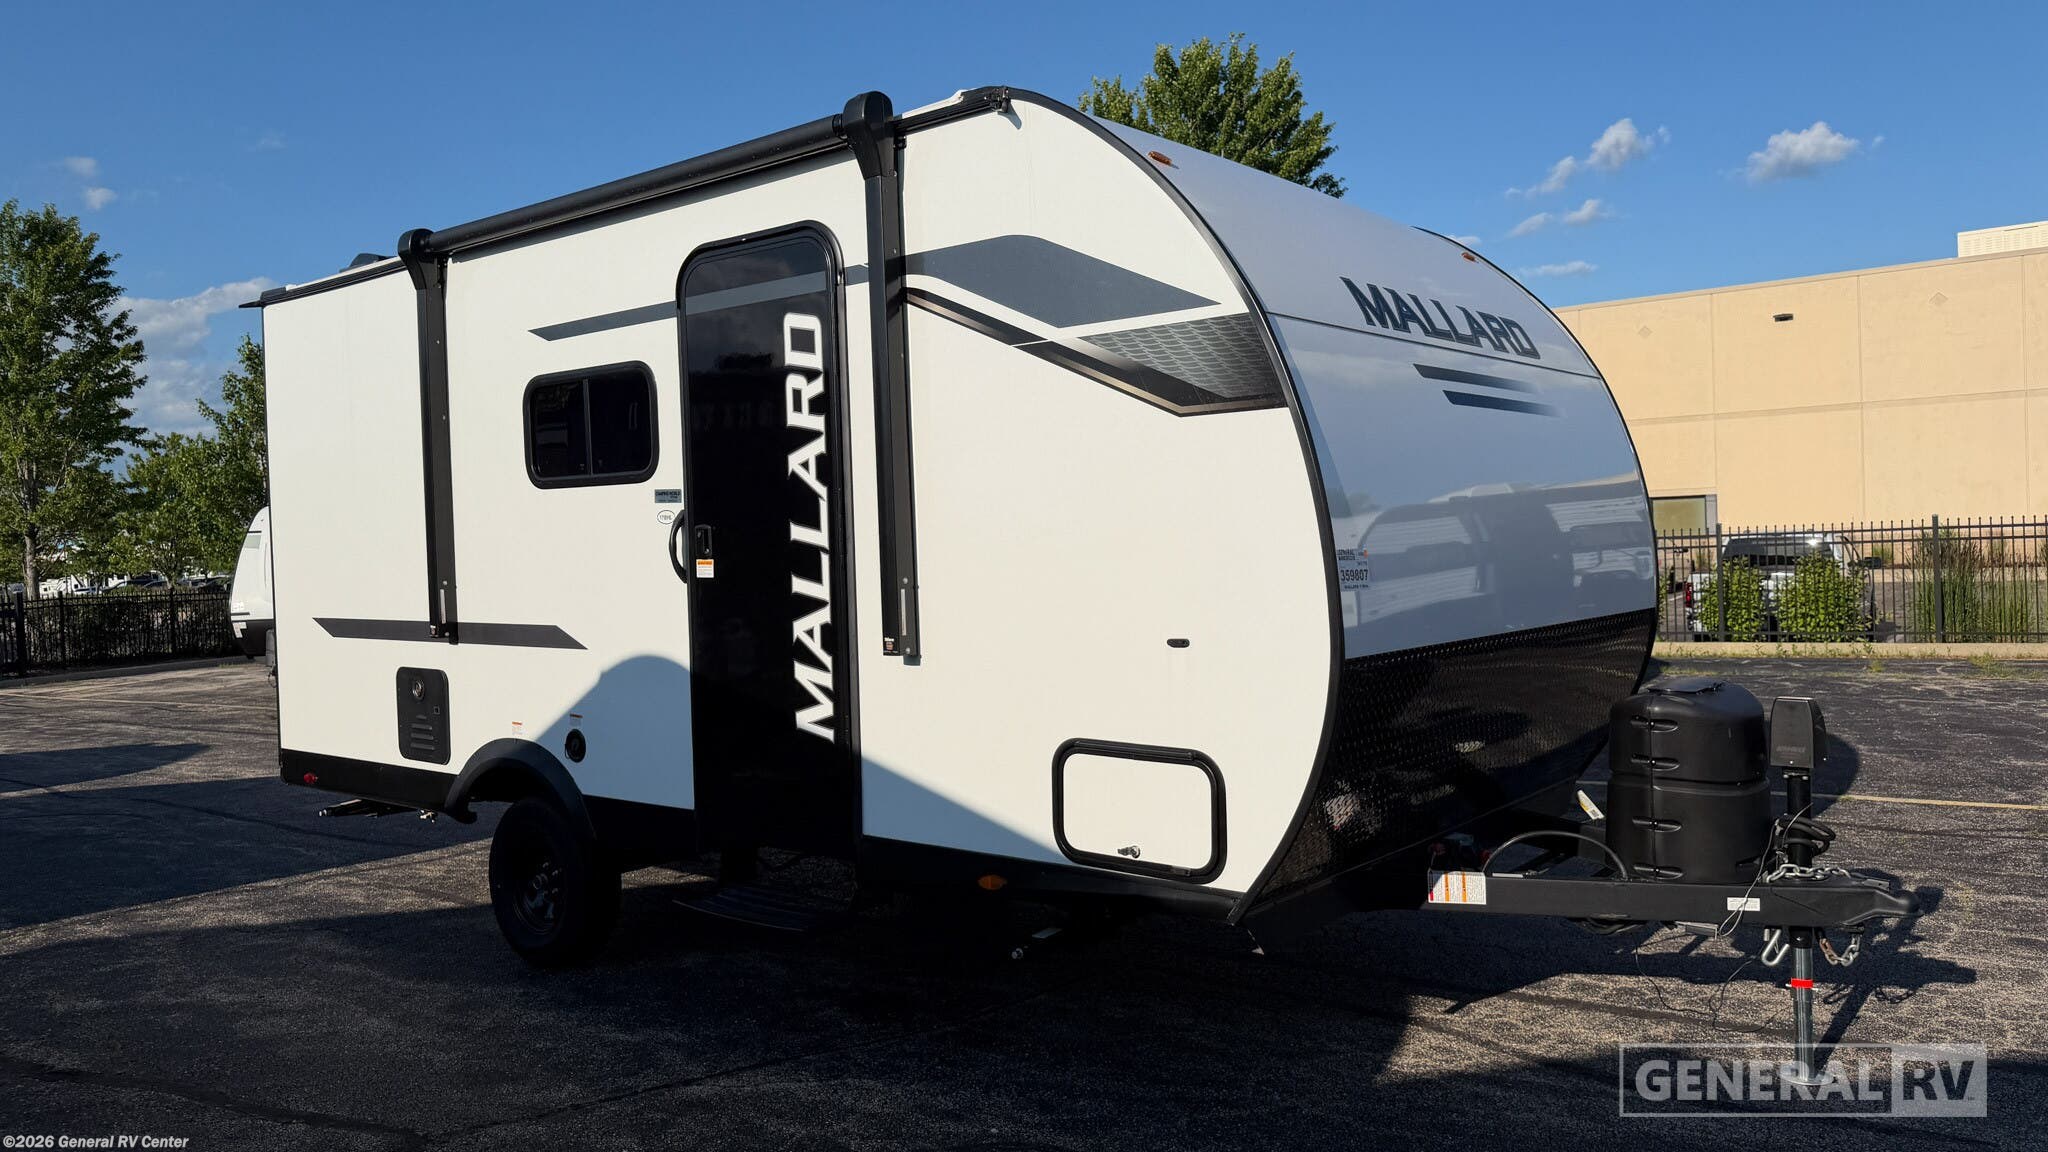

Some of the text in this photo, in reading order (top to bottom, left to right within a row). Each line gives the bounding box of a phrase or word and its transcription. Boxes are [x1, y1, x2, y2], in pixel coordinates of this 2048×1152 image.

[1339, 276, 1541, 359] MALLARD
[783, 312, 835, 743] MALLARD
[1340, 568, 1368, 582] 359807
